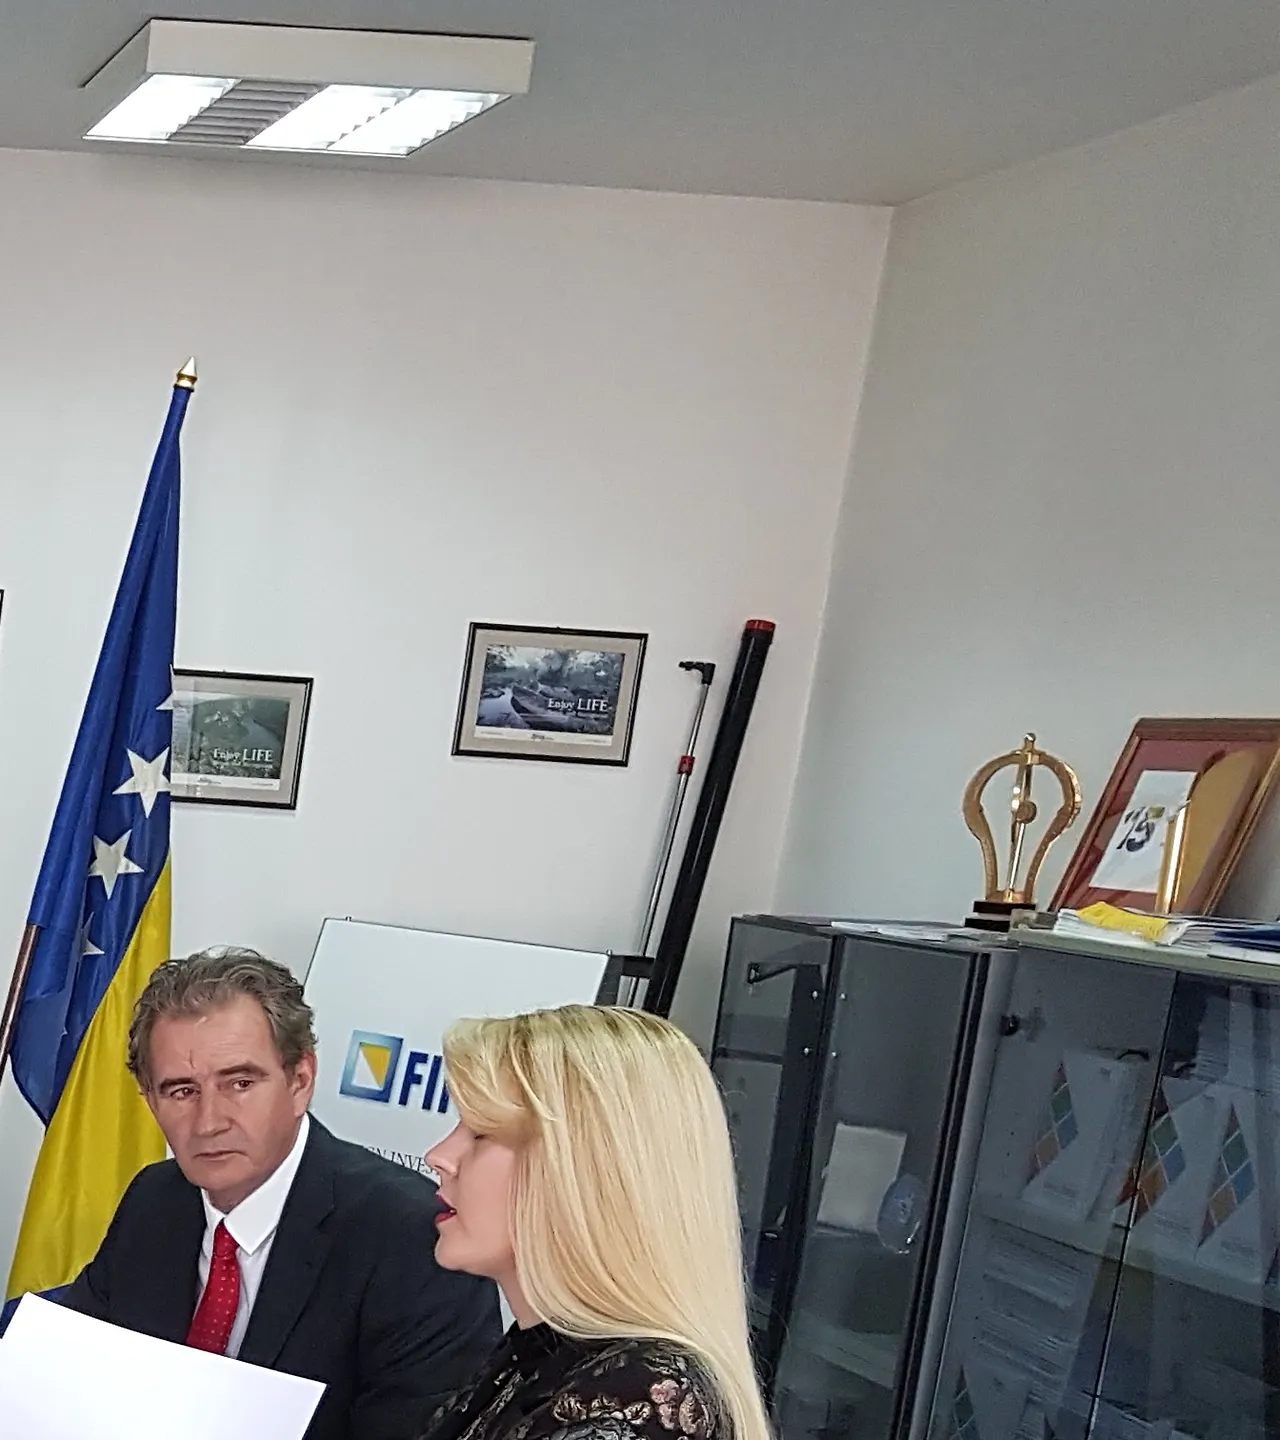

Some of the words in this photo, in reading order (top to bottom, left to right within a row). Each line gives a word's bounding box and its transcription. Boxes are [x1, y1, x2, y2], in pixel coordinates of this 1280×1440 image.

[548, 698, 575, 711] Enjoy
[577, 698, 609, 712] LIFE
[242, 748, 273, 762] LIFE
[398, 1051, 450, 1113] FI
